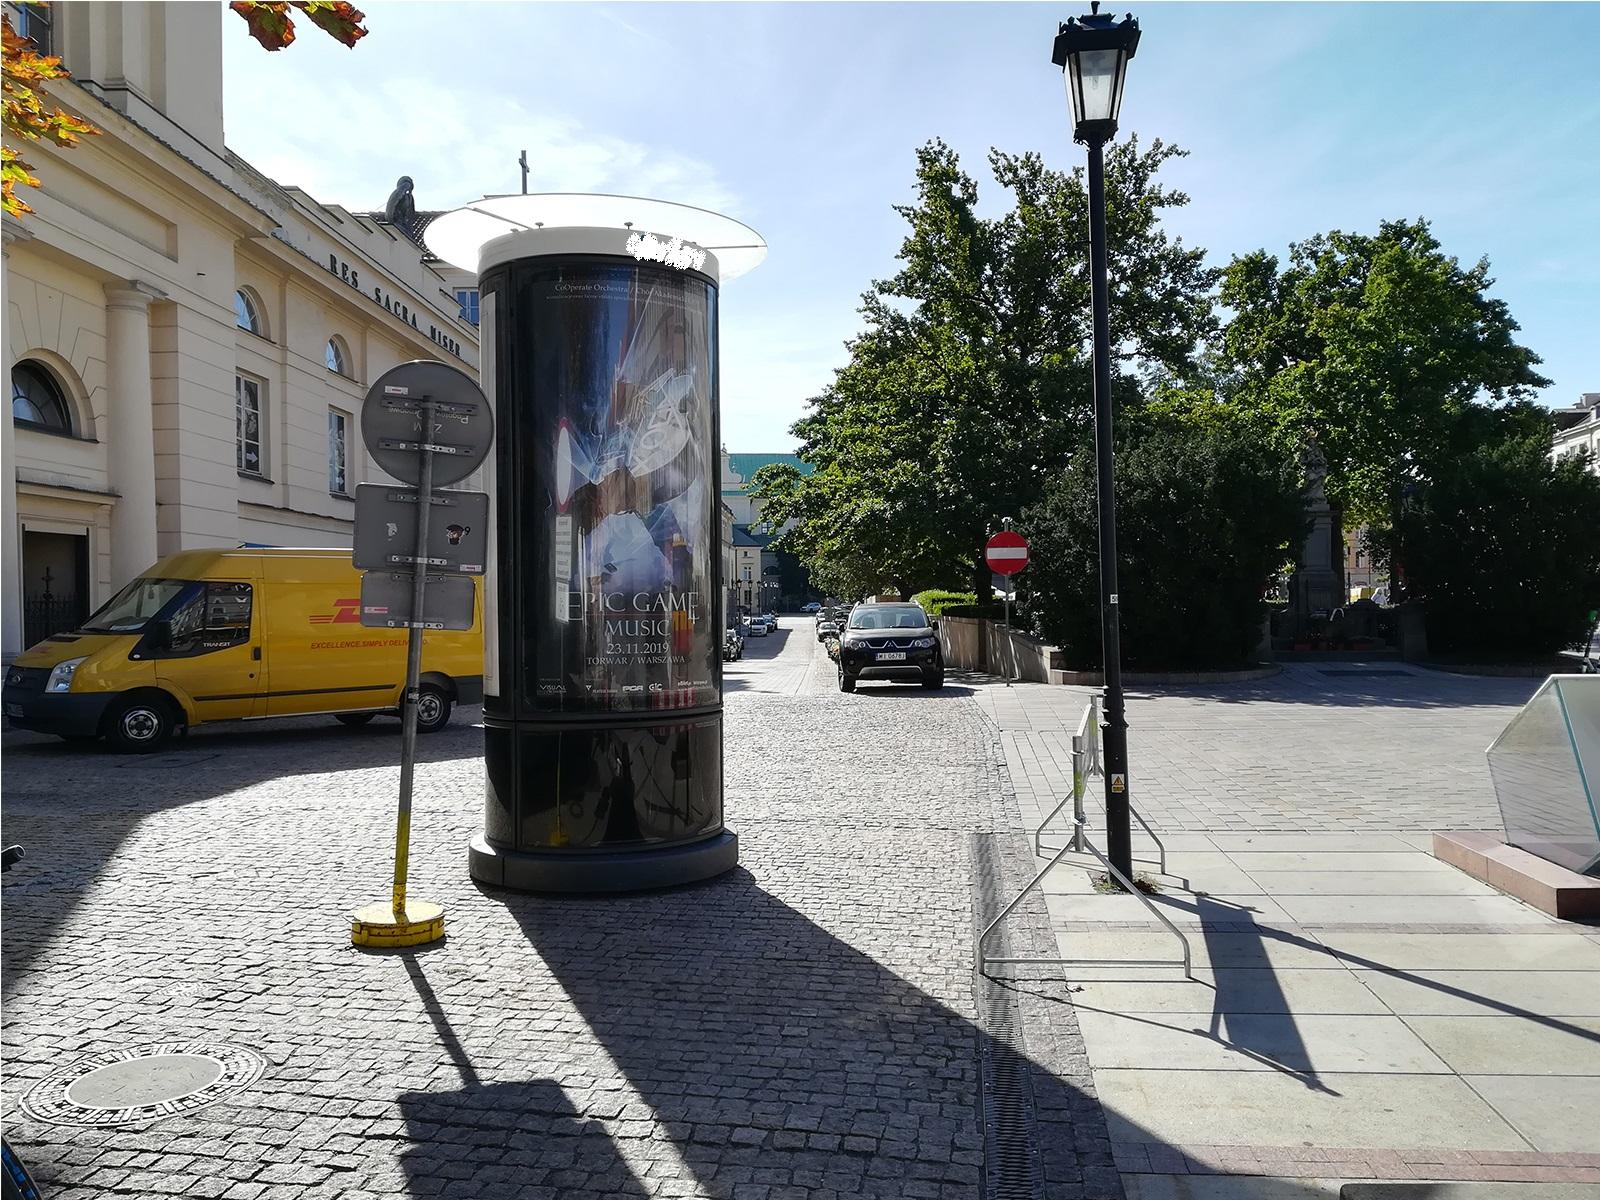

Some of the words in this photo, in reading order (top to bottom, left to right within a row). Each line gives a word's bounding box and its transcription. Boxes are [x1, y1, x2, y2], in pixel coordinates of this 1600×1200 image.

[594, 284, 628, 293] Orchestra
[329, 253, 359, 289] RES
[374, 287, 419, 329] SACRA
[430, 325, 462, 357] MISER
[568, 591, 626, 620] EPIC
[632, 591, 700, 621] GAME
[604, 619, 671, 637] MUSIC
[606, 642, 669, 655] 23.11.2019
[586, 656, 628, 665] TORWAR
[637, 655, 686, 665] WARSZAWA
